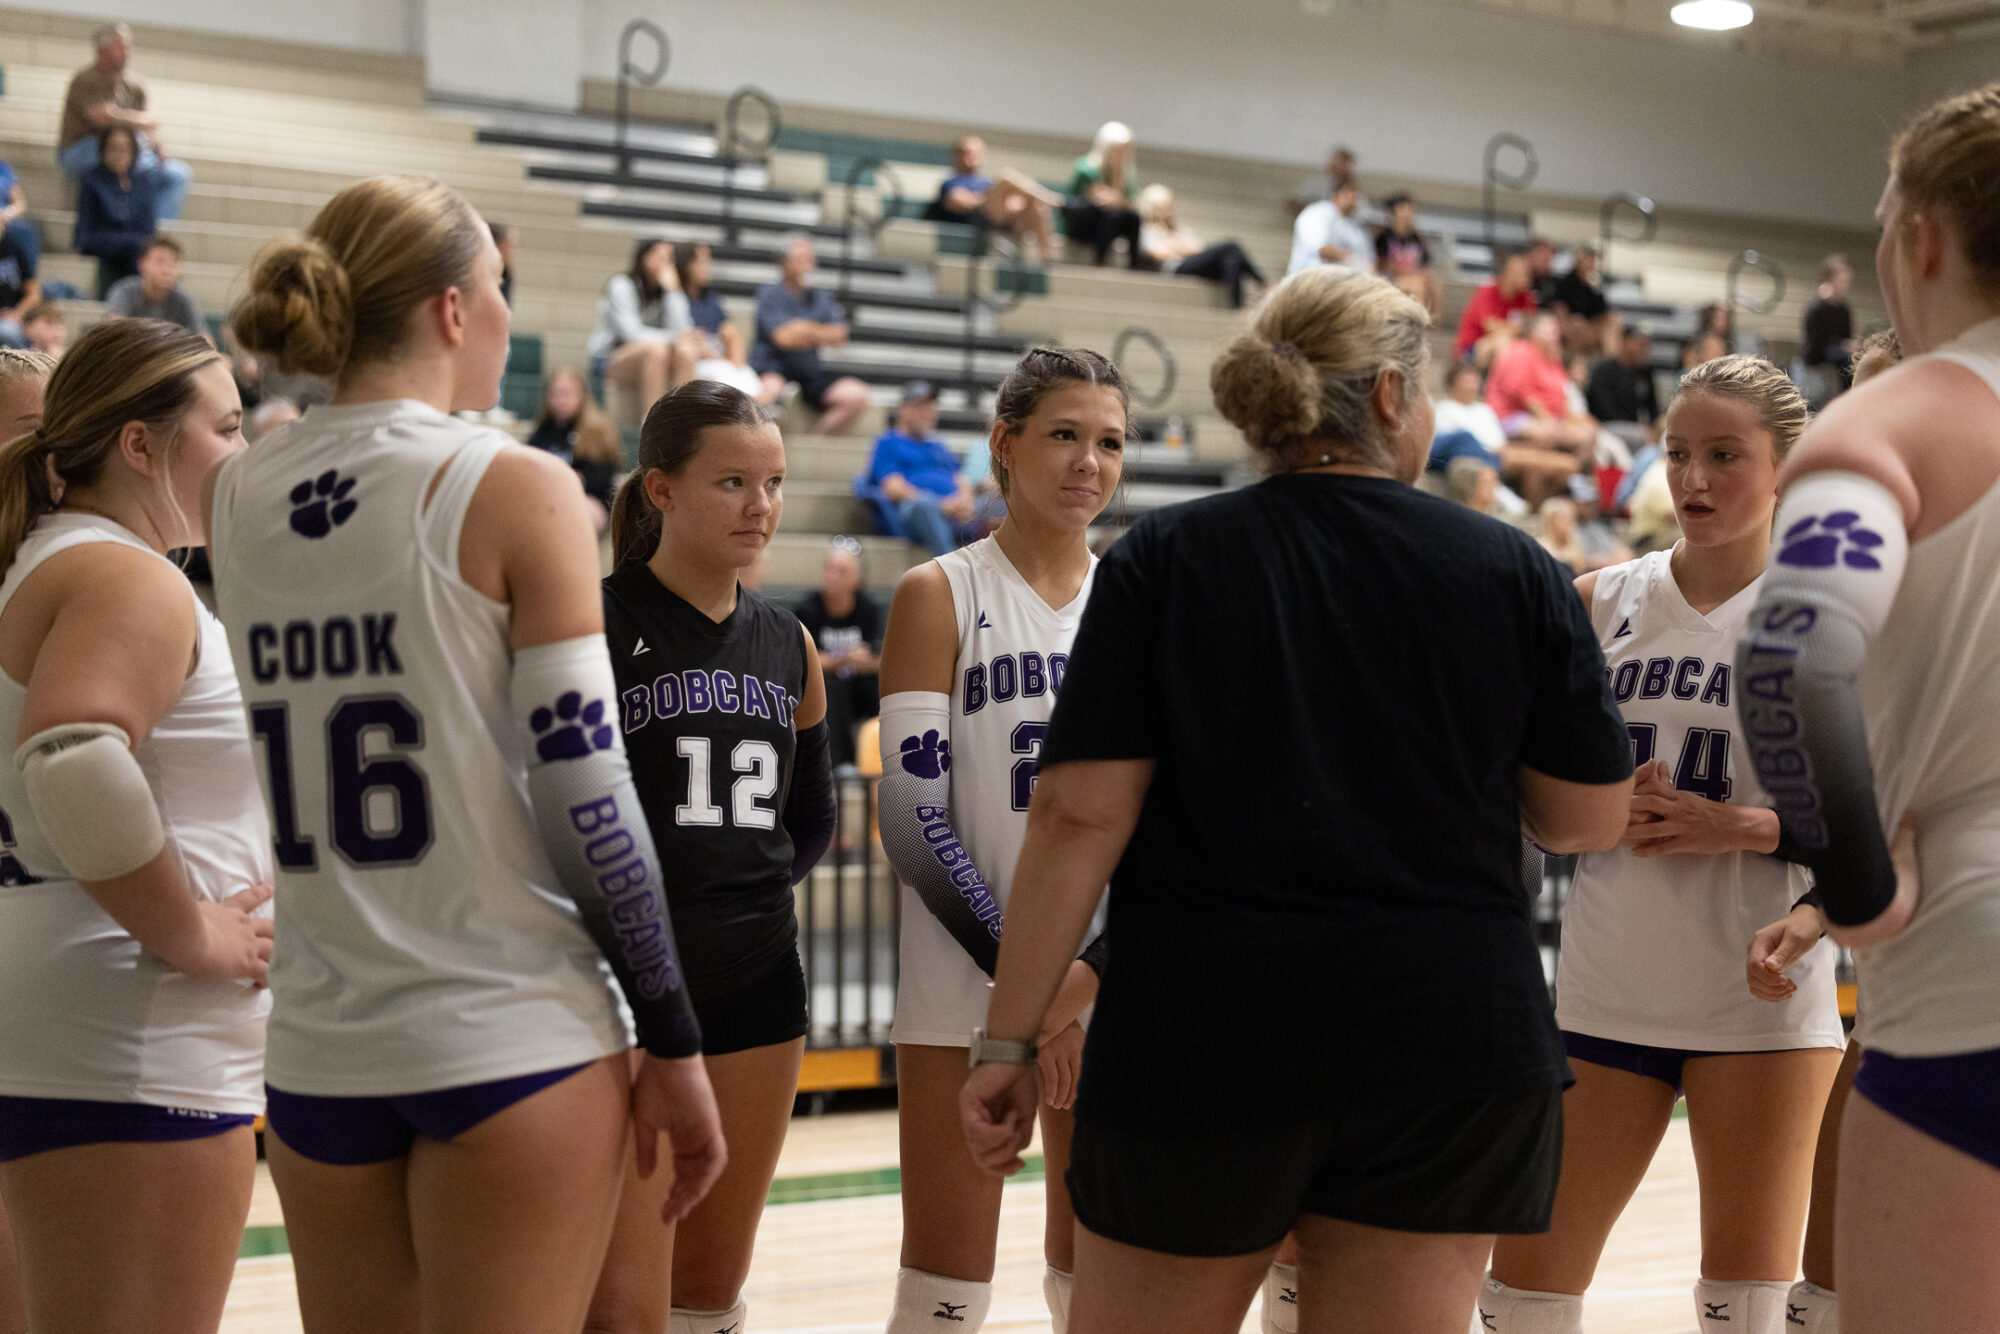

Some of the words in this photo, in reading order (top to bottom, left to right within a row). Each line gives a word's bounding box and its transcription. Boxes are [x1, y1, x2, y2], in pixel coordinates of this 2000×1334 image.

[249, 612, 404, 685] COOK
[1604, 656, 1732, 707] OBCA
[622, 669, 799, 744] BOBCAT
[249, 692, 436, 874] 16
[675, 736, 779, 831] 12
[570, 794, 681, 1000] BOBCATS
